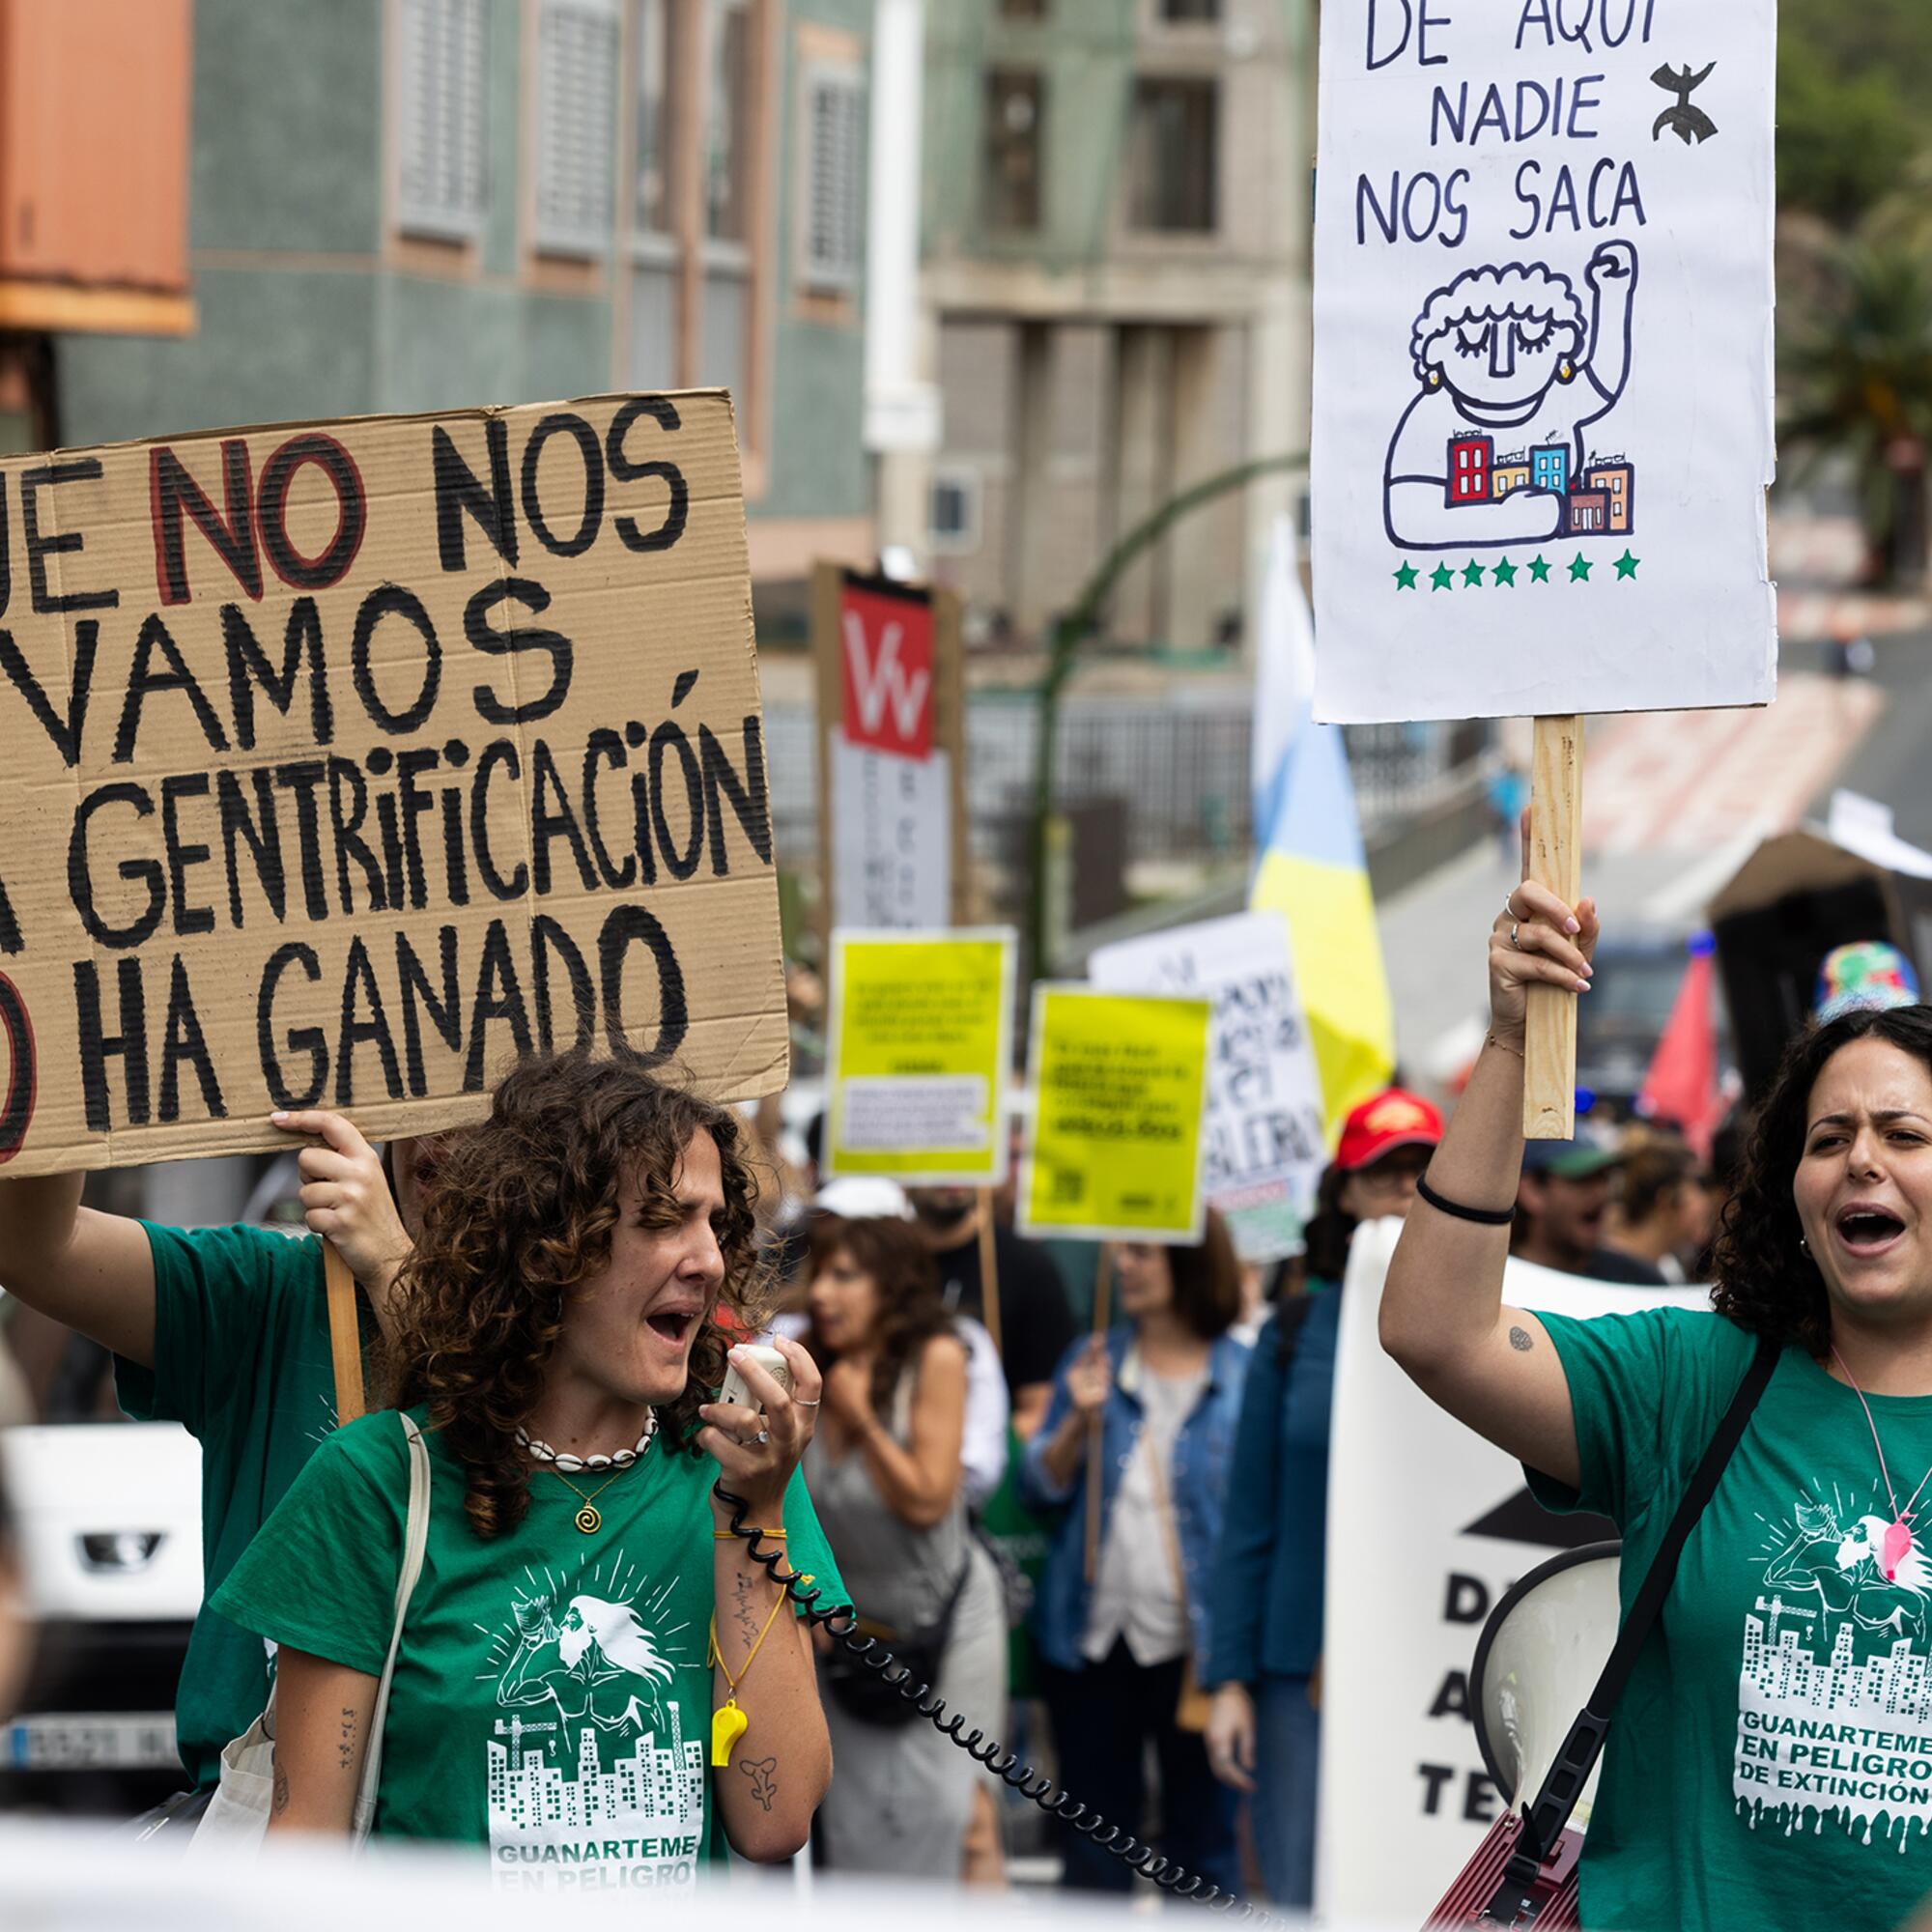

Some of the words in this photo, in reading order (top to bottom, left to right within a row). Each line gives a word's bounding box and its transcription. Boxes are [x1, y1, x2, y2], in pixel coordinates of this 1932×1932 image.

[1367, 0, 1452, 71] DE
[1430, 73, 1605, 146] NADIE
[1355, 168, 1470, 248] NOS
[1509, 156, 1647, 240] SACA
[150, 432, 368, 607] NO
[431, 397, 690, 573] NOS
[0, 578, 574, 769] VAMOS
[73, 952, 229, 1132] HA
[257, 903, 691, 1112] GANADO
[1741, 1734, 1779, 1762] EN
[1789, 1743, 1932, 1781] PELIGRO
[1743, 1711, 1932, 1756] GUANARTEME
[1739, 1761, 1770, 1785] DE
[1777, 1769, 1929, 1805] EXTINCIÓN
[497, 1834, 697, 1864] GUANARTEME
[556, 1861, 692, 1893] PELIGRO
